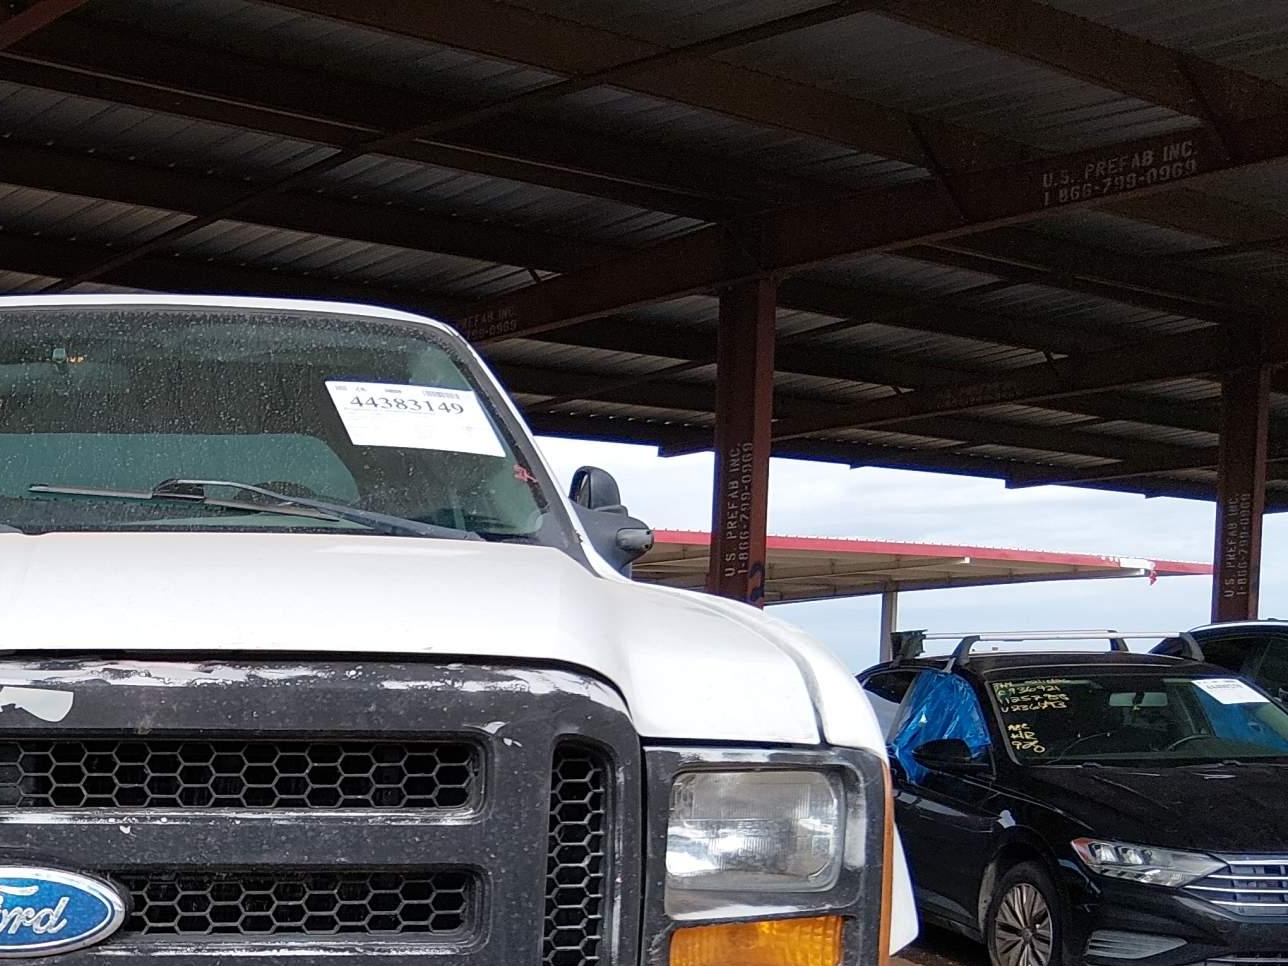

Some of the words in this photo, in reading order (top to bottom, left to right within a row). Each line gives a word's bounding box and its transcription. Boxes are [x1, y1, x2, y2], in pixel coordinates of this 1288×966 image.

[1085, 150, 1154, 180] PREFAB
[1163, 140, 1199, 161] INC.
[350, 396, 464, 415] 44383149
[729, 442, 742, 473] INC.
[727, 480, 740, 540] PREFAB
[1225, 522, 1239, 568] PREFAB
